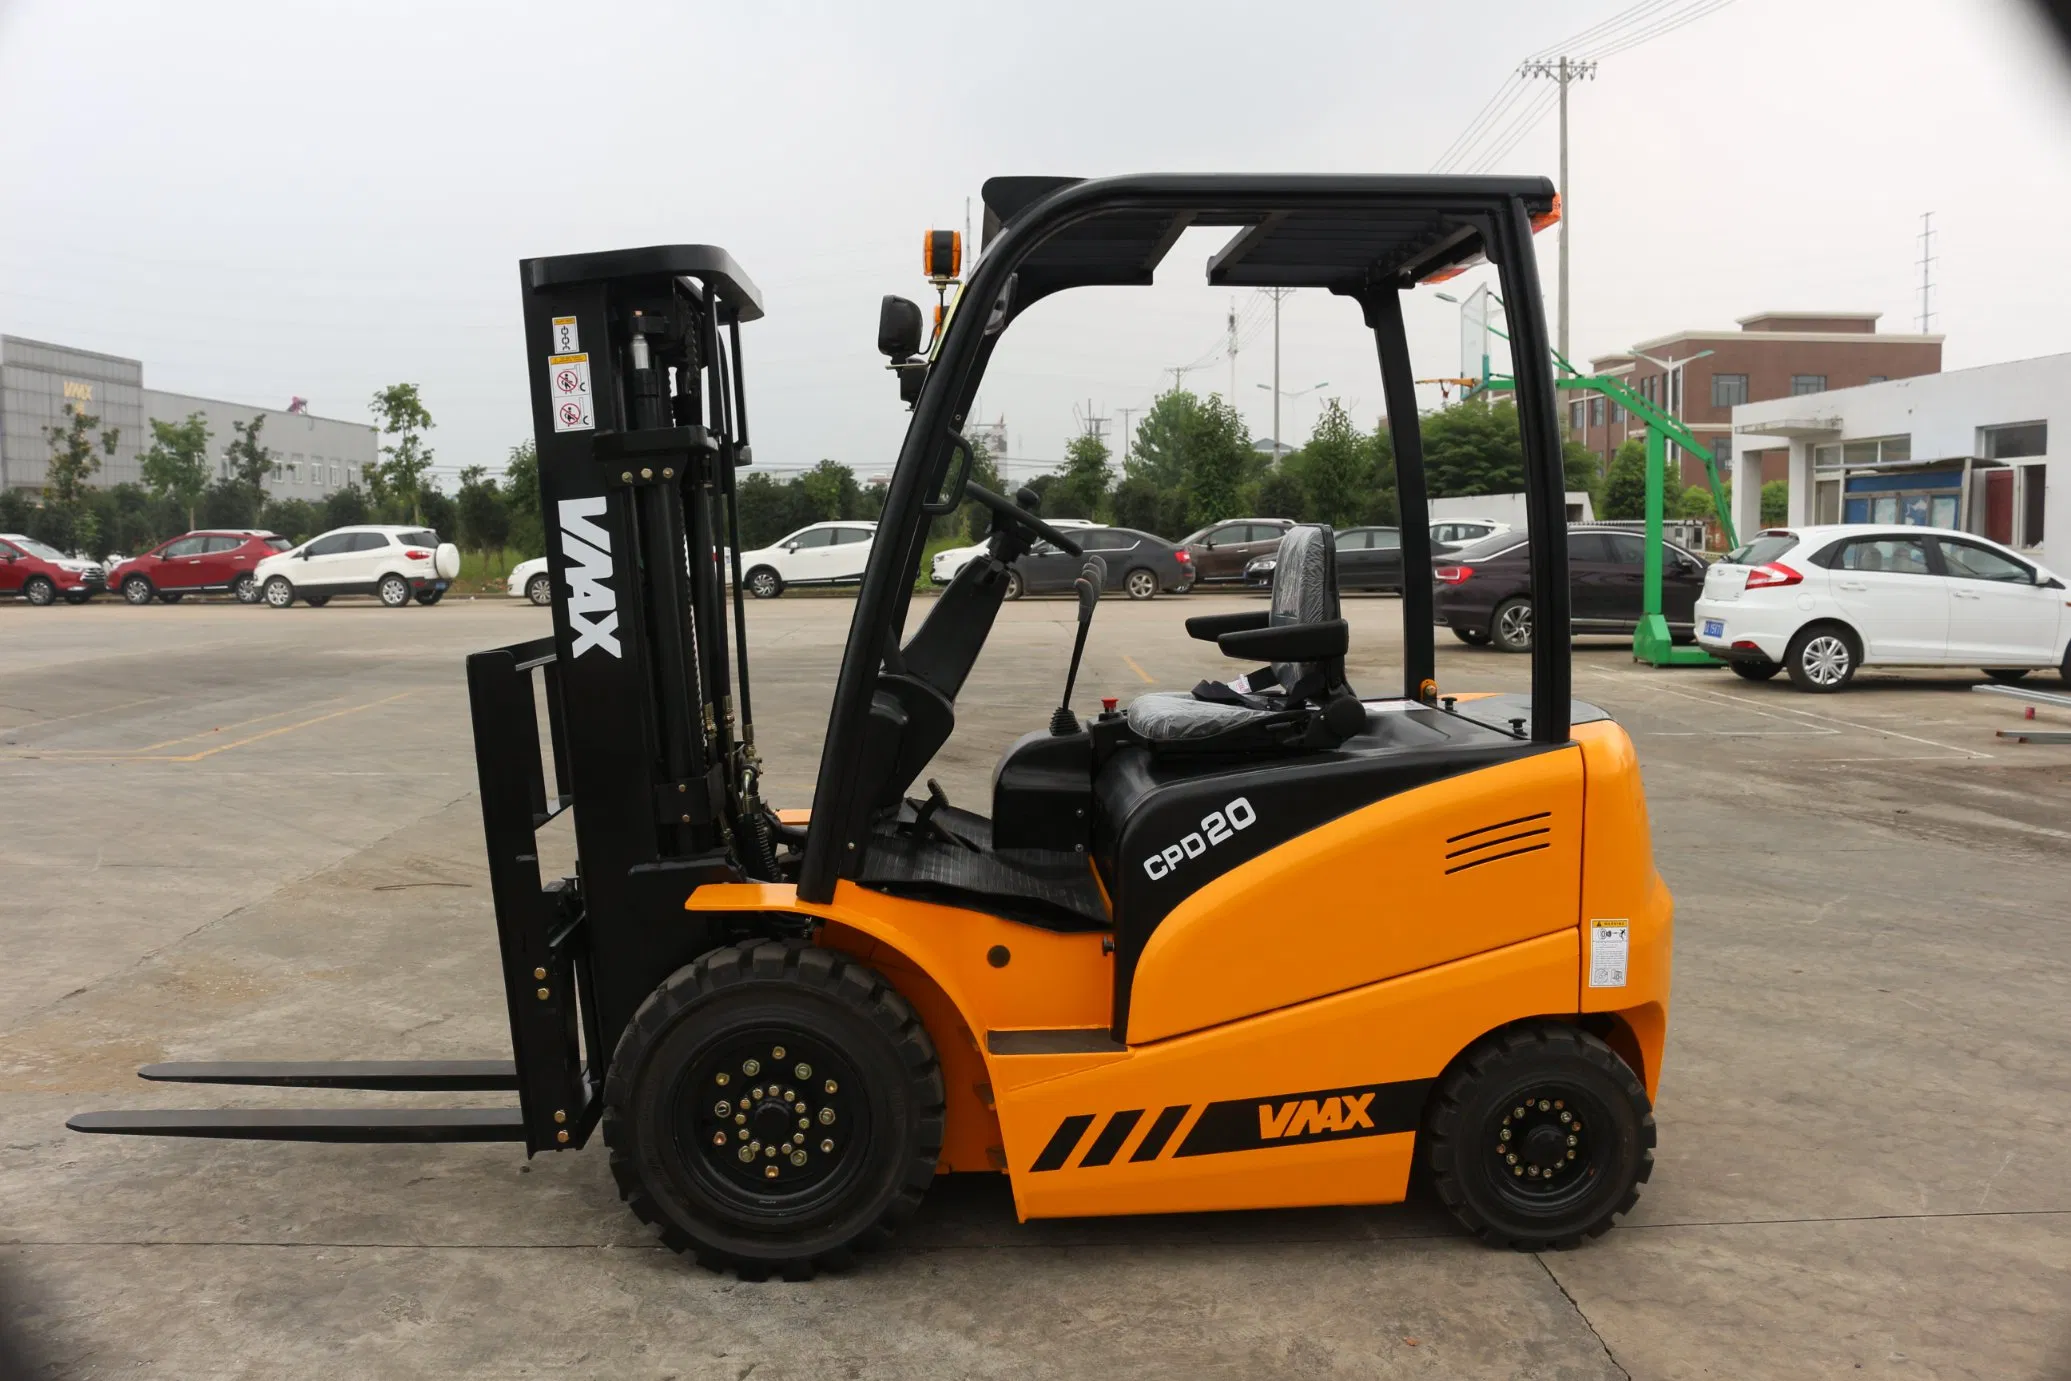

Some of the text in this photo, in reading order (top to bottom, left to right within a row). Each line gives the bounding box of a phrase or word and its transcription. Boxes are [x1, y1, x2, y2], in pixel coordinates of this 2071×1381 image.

[558, 496, 622, 658] VMAX
[1143, 797, 1257, 880] CPD20
[1259, 1092, 1376, 1139] VMAX
